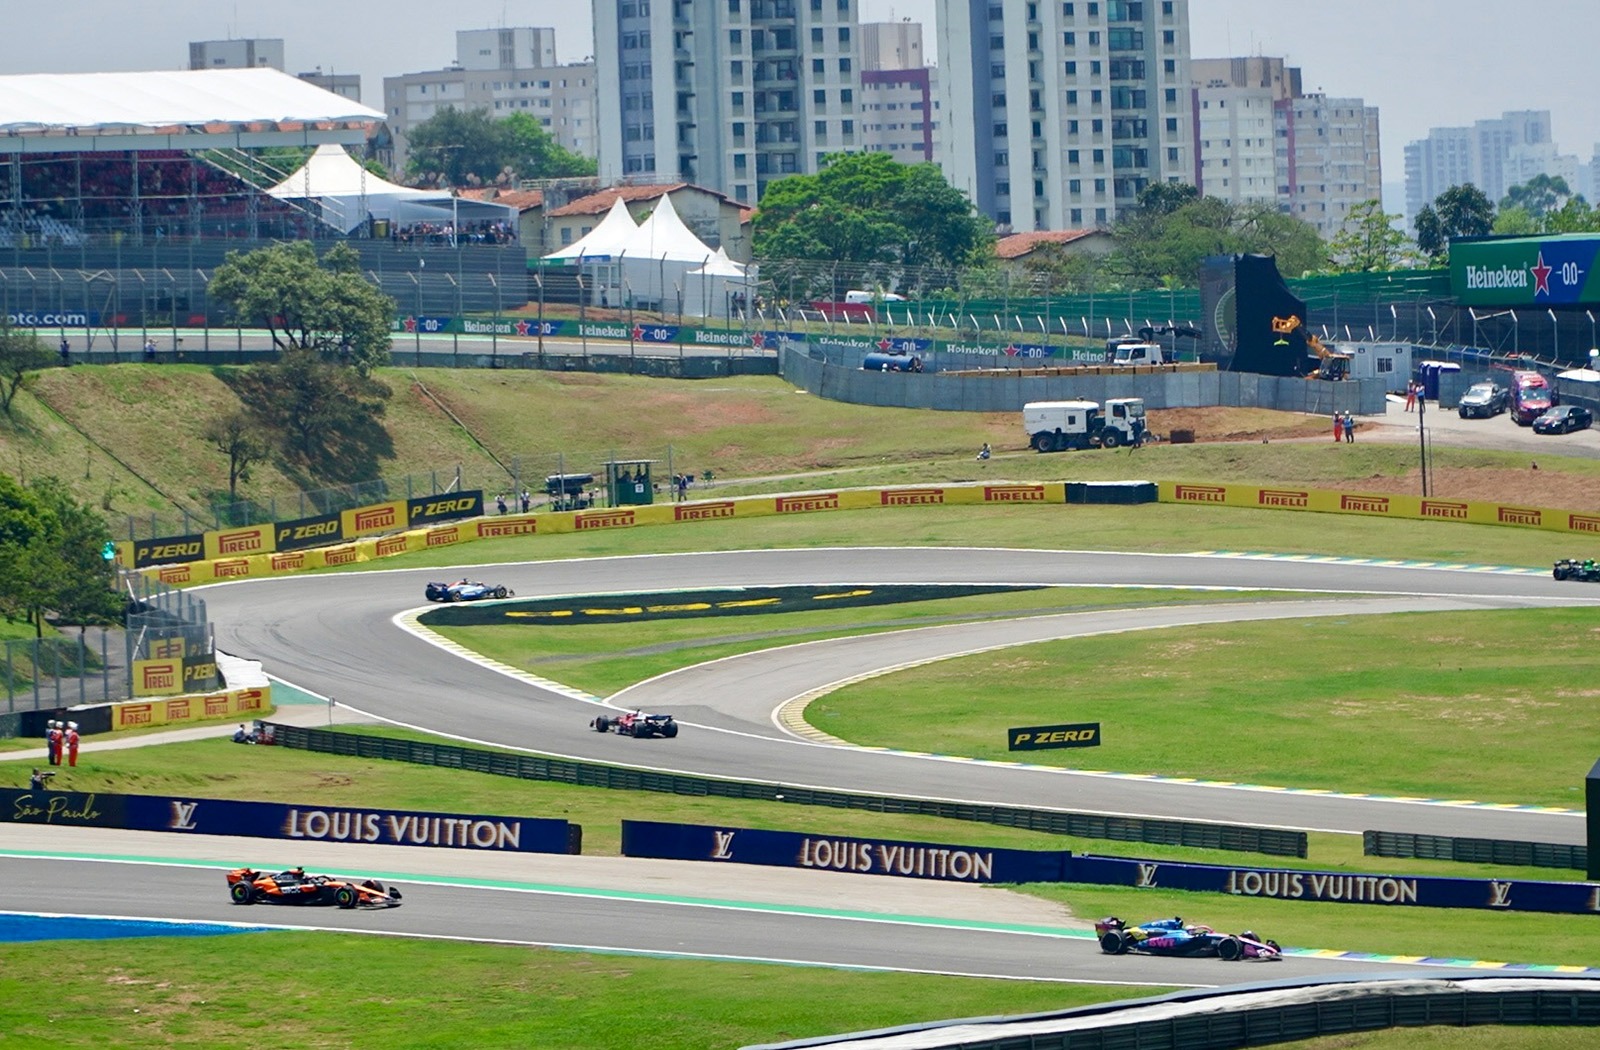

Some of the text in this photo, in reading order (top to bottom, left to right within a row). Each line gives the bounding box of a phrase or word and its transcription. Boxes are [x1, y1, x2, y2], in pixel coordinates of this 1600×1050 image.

[1466, 262, 1578, 289] Heineken 0.0
[1, 313, 86, 325] oto.com
[464, 320, 512, 334] Heineken
[578, 324, 628, 338] Heineken
[946, 343, 1000, 356] Heineken
[776, 493, 838, 512] PIRELLI
[881, 489, 944, 505] PIRELLI
[984, 485, 1045, 501] PIRELLI
[1175, 485, 1226, 502] PIRELLI
[1259, 489, 1309, 507] PIRELLI
[411, 498, 476, 518] P ZERO
[674, 502, 735, 521] PIRELLI
[1340, 494, 1389, 513] PIRELLI
[1421, 500, 1468, 519] PIRELLI
[355, 507, 395, 531] PIRELLI
[575, 510, 635, 529] PIRELLI
[1498, 506, 1541, 525] PIRELLI
[279, 521, 338, 542] P ZERO
[426, 527, 458, 546] PIRELLI
[478, 519, 537, 537] PIRELLI
[137, 548, 148, 561] P
[151, 542, 201, 559] ZERO
[219, 530, 261, 554] PIRELLI
[375, 536, 407, 556] PIRELLI
[271, 553, 304, 570] PIRELLI
[324, 547, 356, 565] PIRELLI
[159, 566, 190, 584] PIRELLI
[214, 560, 249, 577] PIRELLI
[143, 665, 174, 689] PIRELLI
[184, 667, 192, 681] P
[1014, 729, 1095, 745] P ZERO
[13, 793, 101, 822] São Paulo
[285, 809, 521, 848] LOUIS VUITTON
[801, 838, 993, 880] LOUIS VUITTON
[1230, 870, 1418, 903] LOUIS VUITTON
